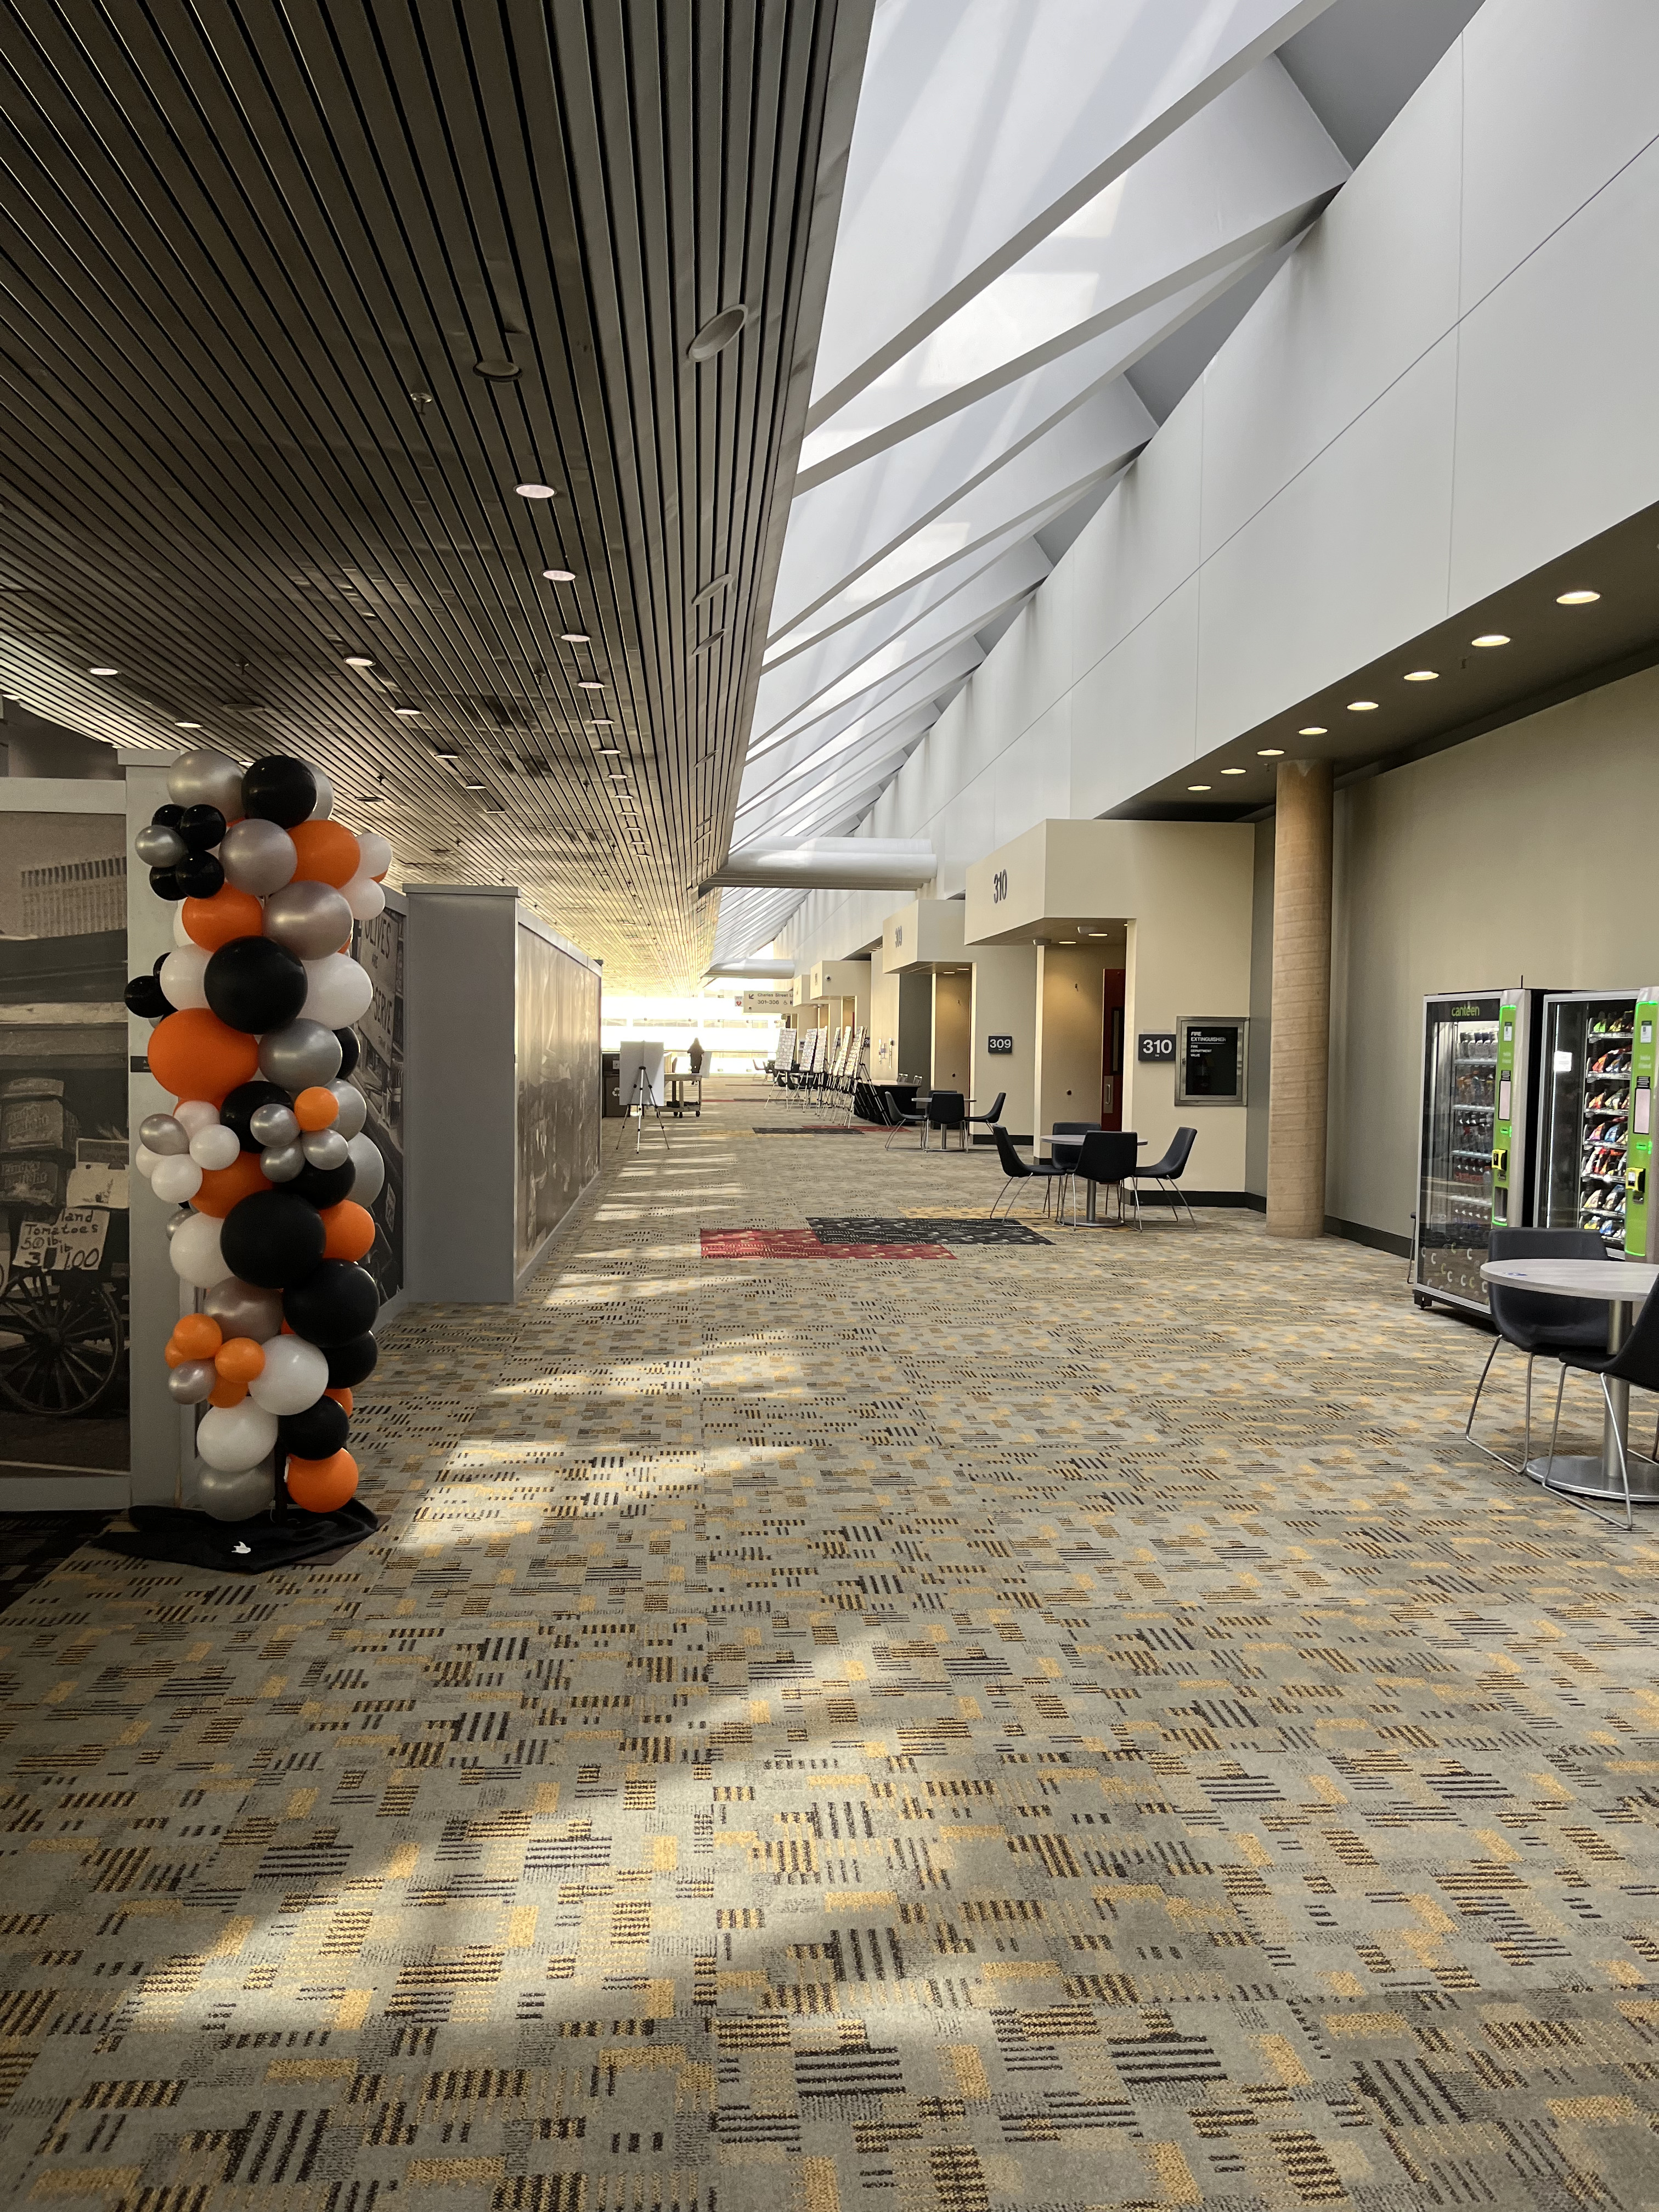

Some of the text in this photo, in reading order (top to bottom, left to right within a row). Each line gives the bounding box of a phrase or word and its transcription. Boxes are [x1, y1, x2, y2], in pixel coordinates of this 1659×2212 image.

[994, 869, 1007, 904] 310
[1451, 1003, 1480, 1017] canteen
[989, 1039, 1012, 1048] 309
[1143, 1039, 1172, 1054] 310
[24, 1223, 99, 1235] Tomatoes
